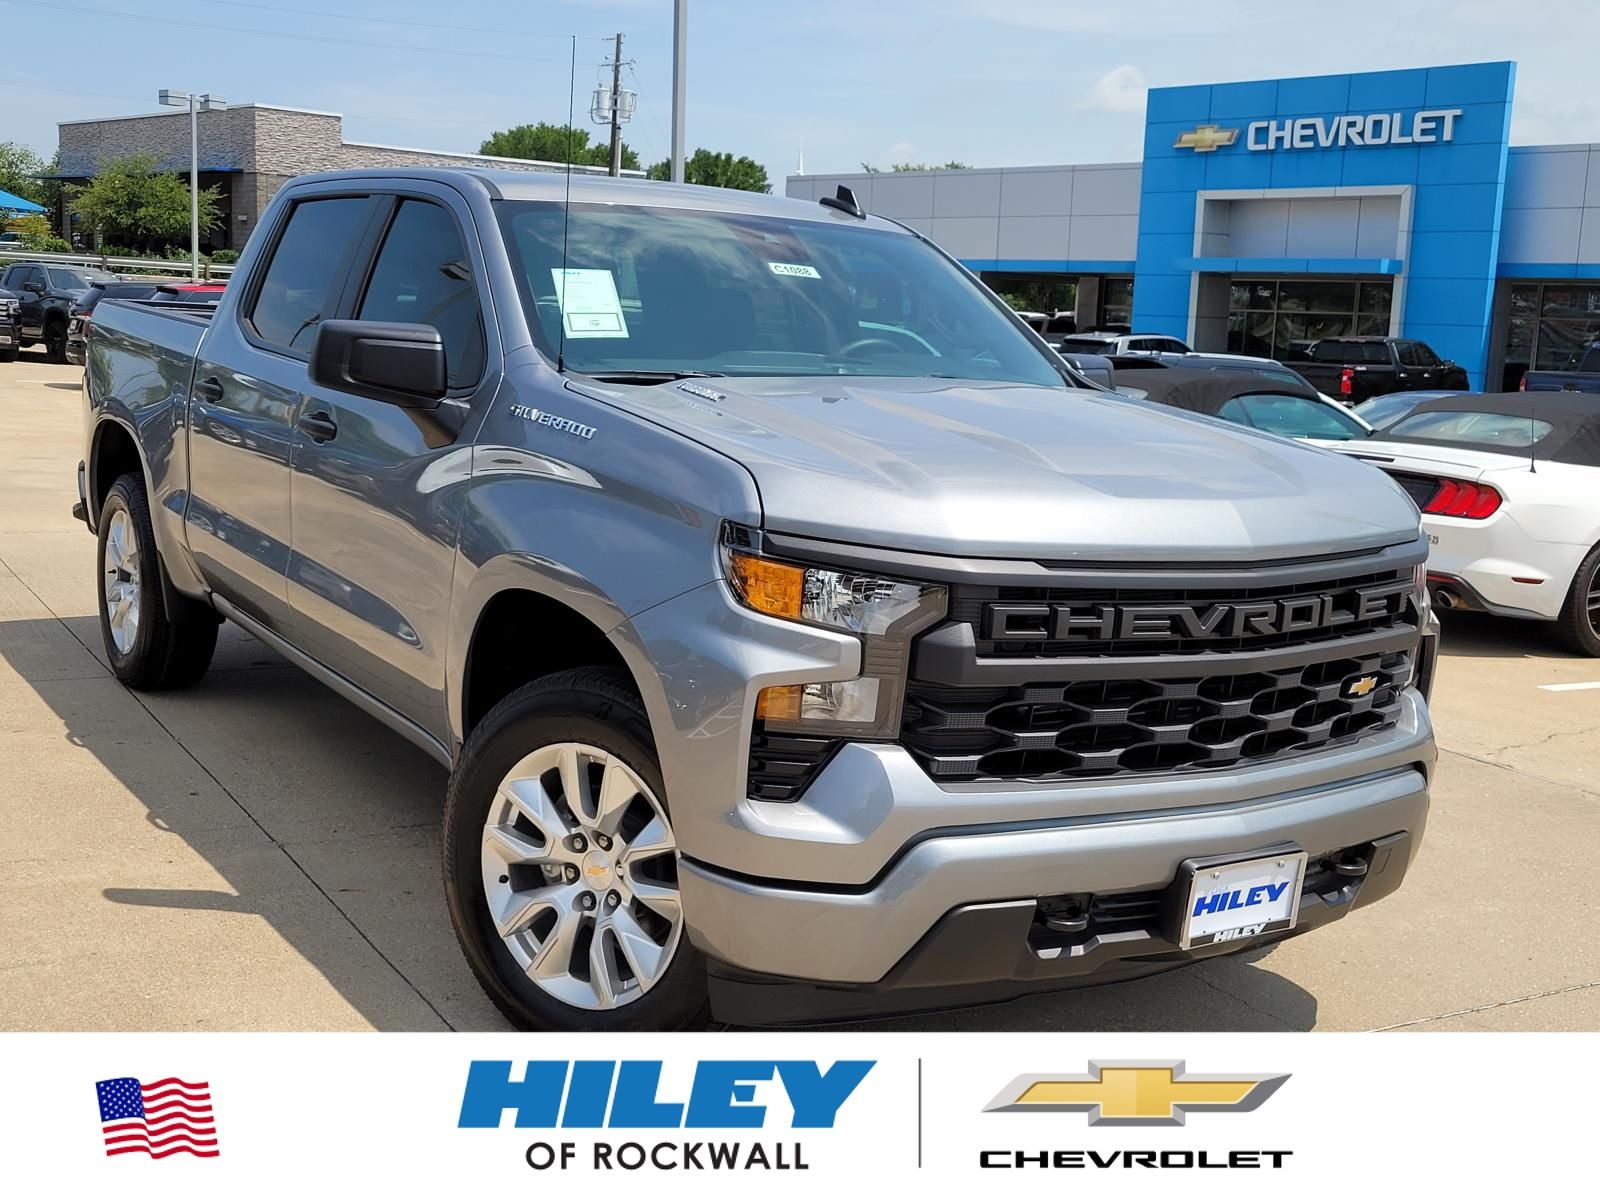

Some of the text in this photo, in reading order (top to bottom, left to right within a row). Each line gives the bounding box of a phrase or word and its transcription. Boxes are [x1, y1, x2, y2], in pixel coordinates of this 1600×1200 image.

[1247, 108, 1463, 151] CHEVROLET
[774, 265, 812, 276] C1088
[510, 404, 598, 440] SILVERADO
[1192, 881, 1290, 917] HILEY
[1213, 923, 1267, 943] HILEY
